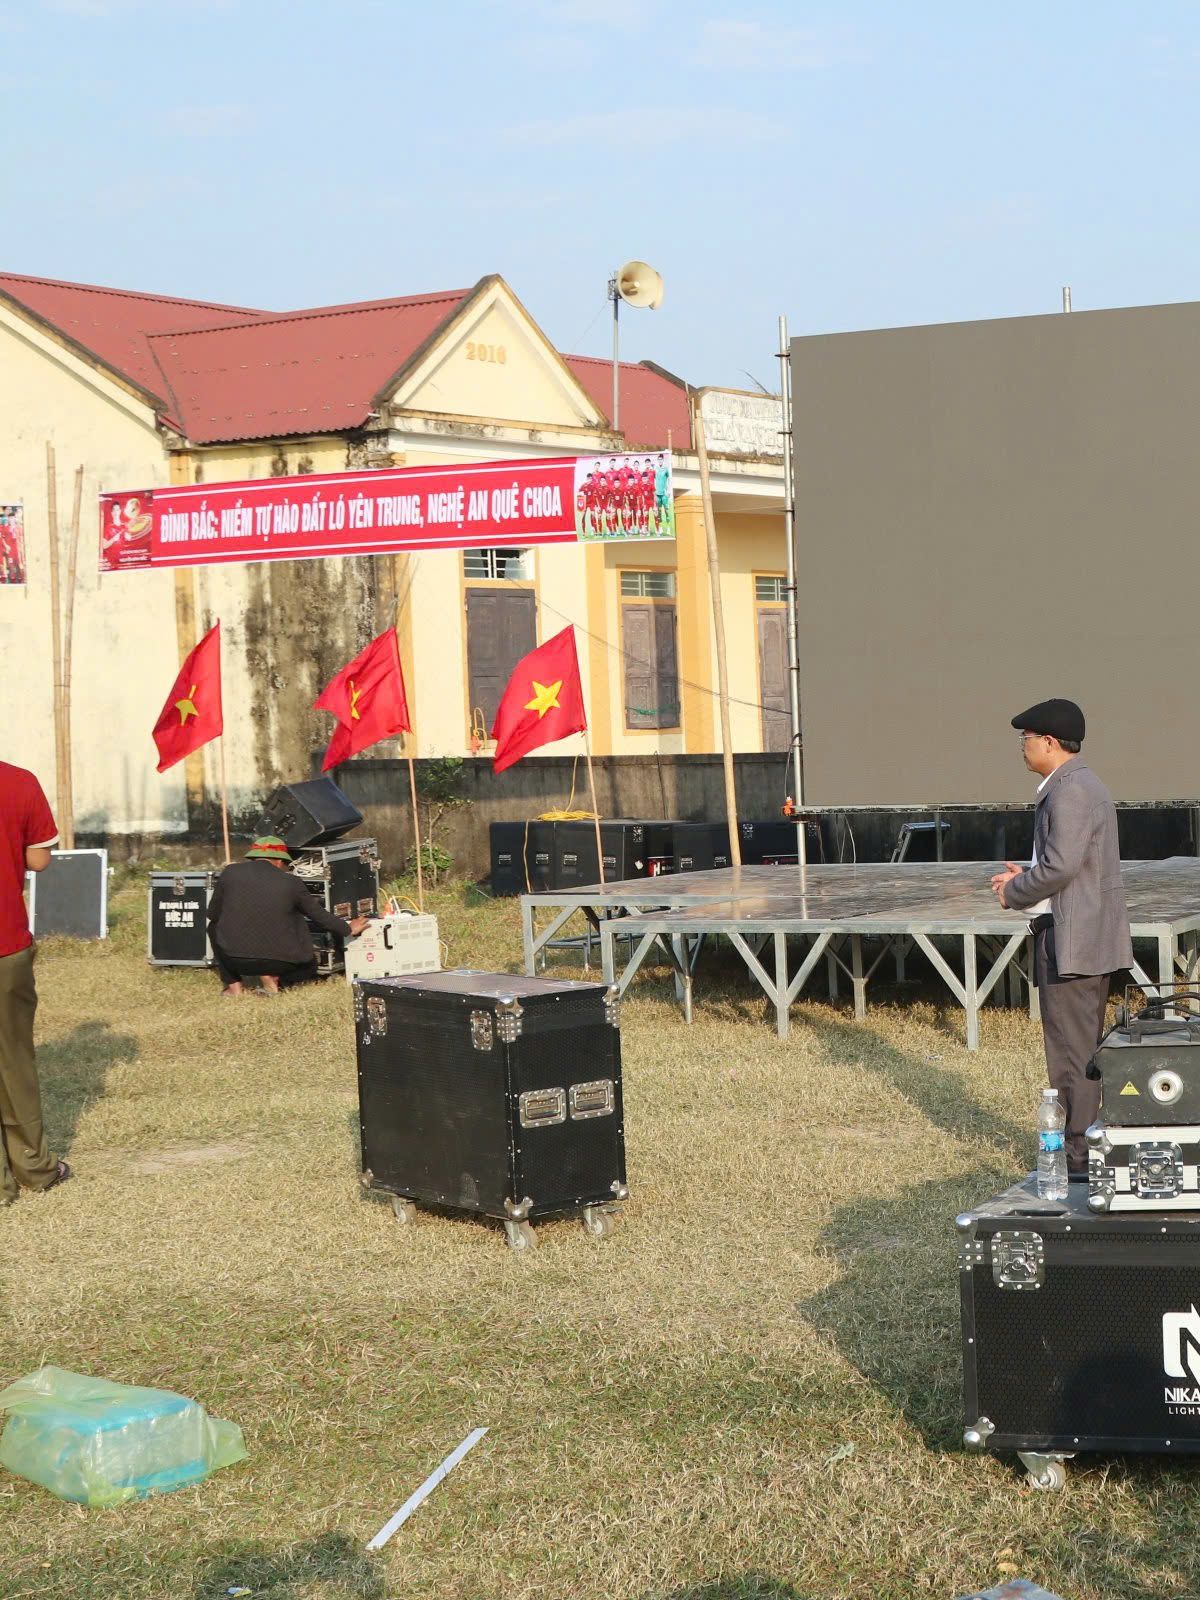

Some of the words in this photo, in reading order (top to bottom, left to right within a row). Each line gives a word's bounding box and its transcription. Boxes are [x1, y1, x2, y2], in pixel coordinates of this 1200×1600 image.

[160, 508, 189, 543] ĐÌNH
[191, 500, 219, 541] BẮC:
[255, 503, 273, 542] TỰ
[273, 498, 299, 534] HÀO
[302, 491, 327, 533] ĐẤT
[328, 494, 345, 531] LÓ
[348, 492, 374, 529] YÊN
[377, 495, 424, 528] TRUNG,
[427, 485, 465, 529] NGHỆ
[468, 490, 488, 521] AN
[491, 482, 519, 523] QUÊ
[522, 486, 562, 518] CHOA
